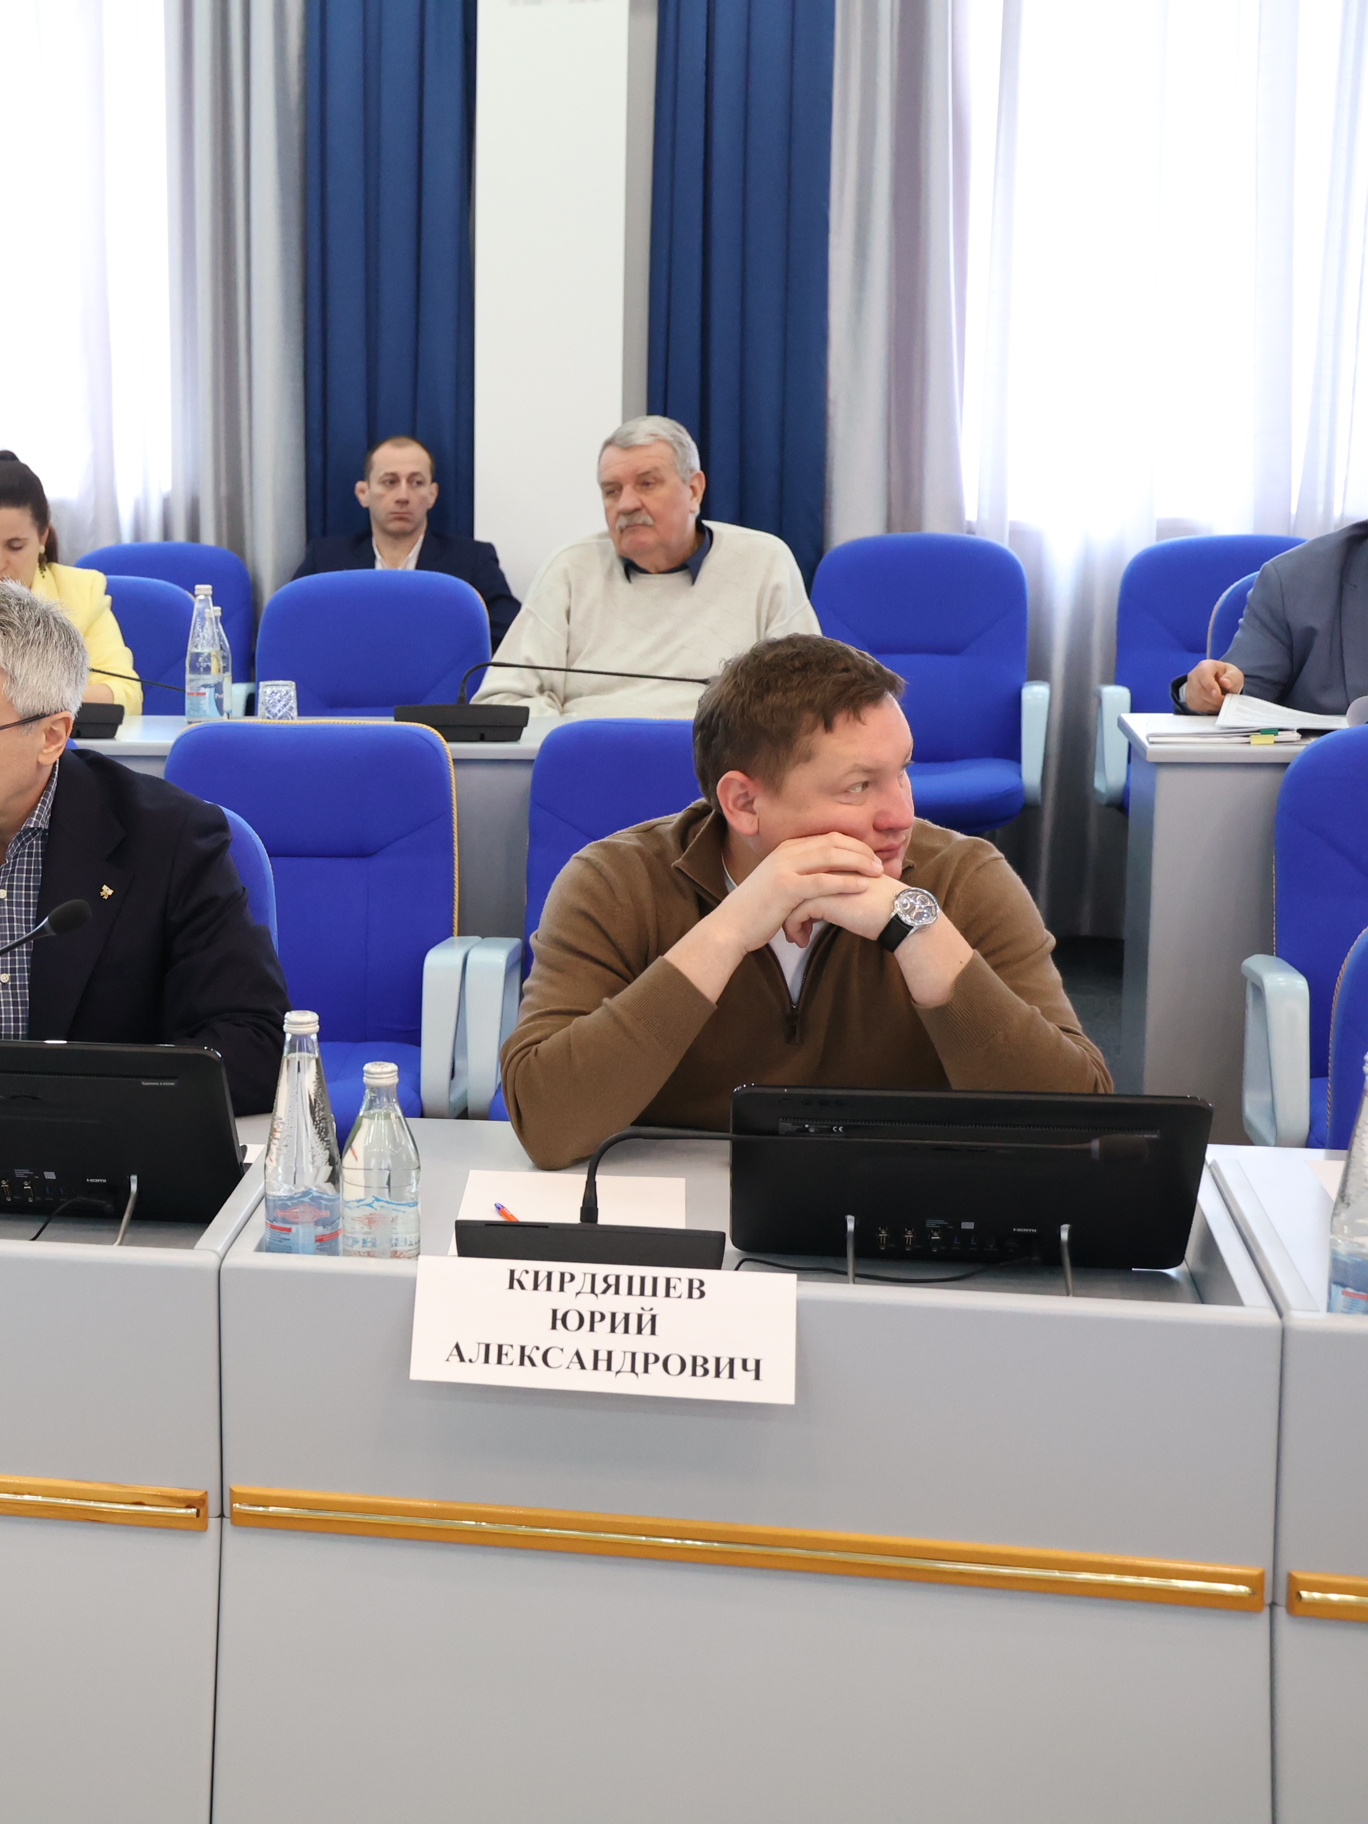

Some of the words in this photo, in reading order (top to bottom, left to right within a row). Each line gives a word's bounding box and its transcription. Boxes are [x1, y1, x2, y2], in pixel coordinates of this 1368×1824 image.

[506, 1268, 707, 1301] КИРДЯШЕВ
[549, 1306, 659, 1337] ЮРИЙ
[445, 1340, 763, 1382] АЛЕКСАНДРОВИЧ
